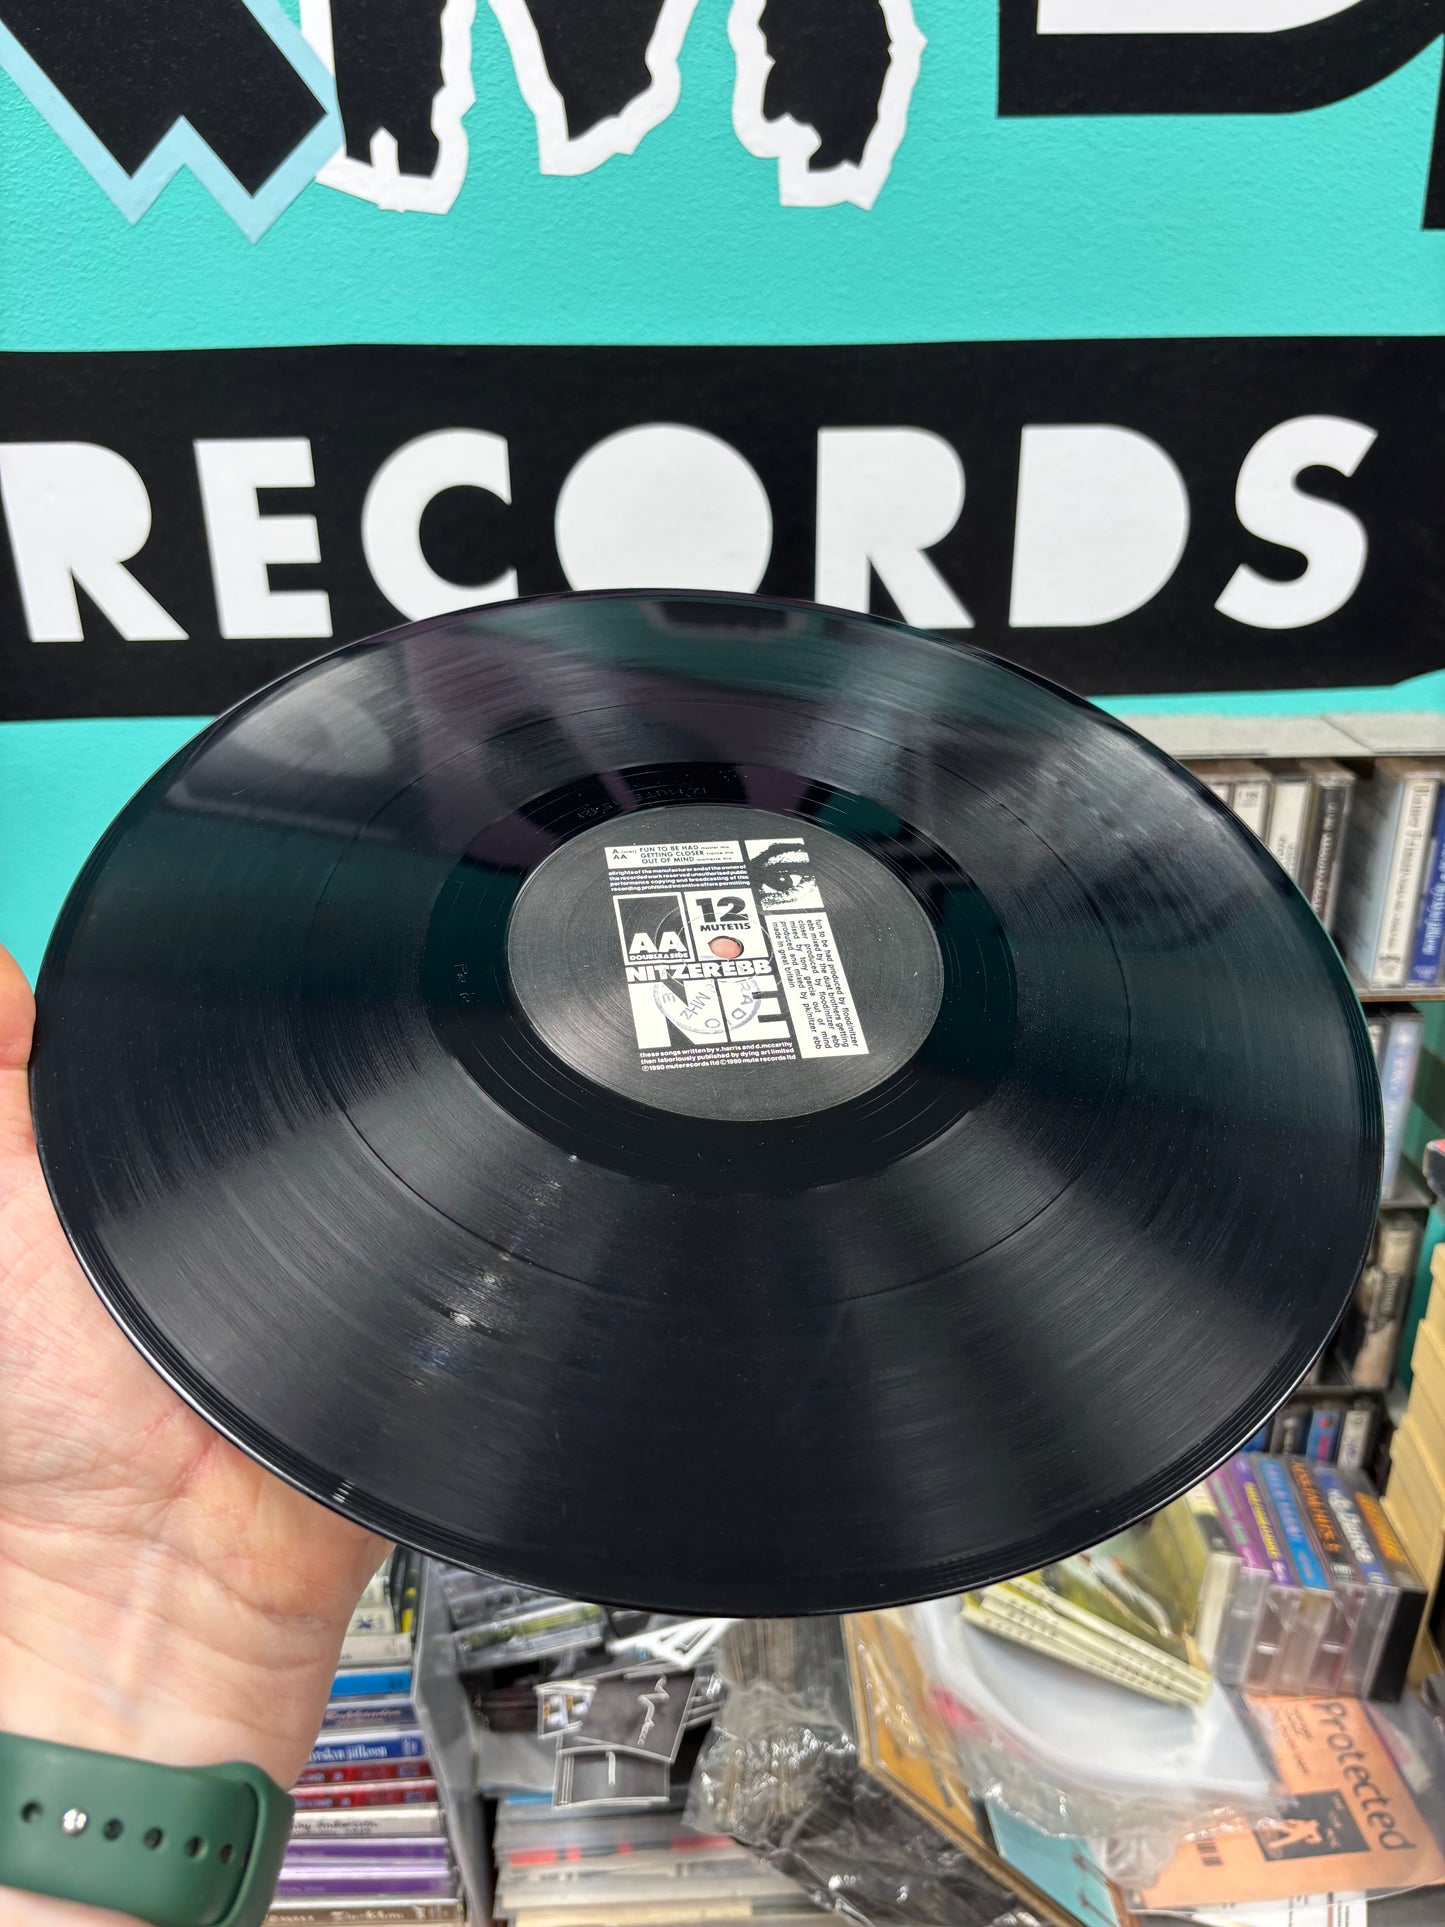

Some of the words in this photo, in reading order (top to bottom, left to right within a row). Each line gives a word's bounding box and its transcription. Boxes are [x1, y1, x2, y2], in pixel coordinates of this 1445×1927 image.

[0, 414, 1378, 643] RECORDS
[696, 896, 748, 922] 12
[700, 922, 751, 932] MUTE115
[780, 921, 794, 950] produced
[629, 931, 687, 954] AA
[772, 922, 782, 939] made
[778, 950, 790, 966] great
[785, 967, 796, 988] britain
[790, 954, 800, 966] and
[824, 950, 834, 962] had
[790, 921, 800, 939] mixed
[800, 957, 808, 971] tony
[804, 976, 816, 996] garcia
[812, 1002, 821, 1012] out
[821, 1031, 832, 1049] mind
[794, 969, 806, 988] mixed
[798, 920, 808, 939] closer
[803, 944, 820, 974] produced
[831, 1035, 840, 1048] ebb
[807, 920, 815, 931] ebb
[811, 933, 822, 951] mixed
[823, 976, 833, 990] dust
[828, 992, 842, 1020] brothers
[835, 1023, 849, 1047] getting
[828, 964, 845, 994] produced
[800, 991, 808, 1000] by
[838, 997, 846, 1005] by
[813, 1036, 822, 1050] ebb
[1313, 1702, 1417, 1851] Protected
